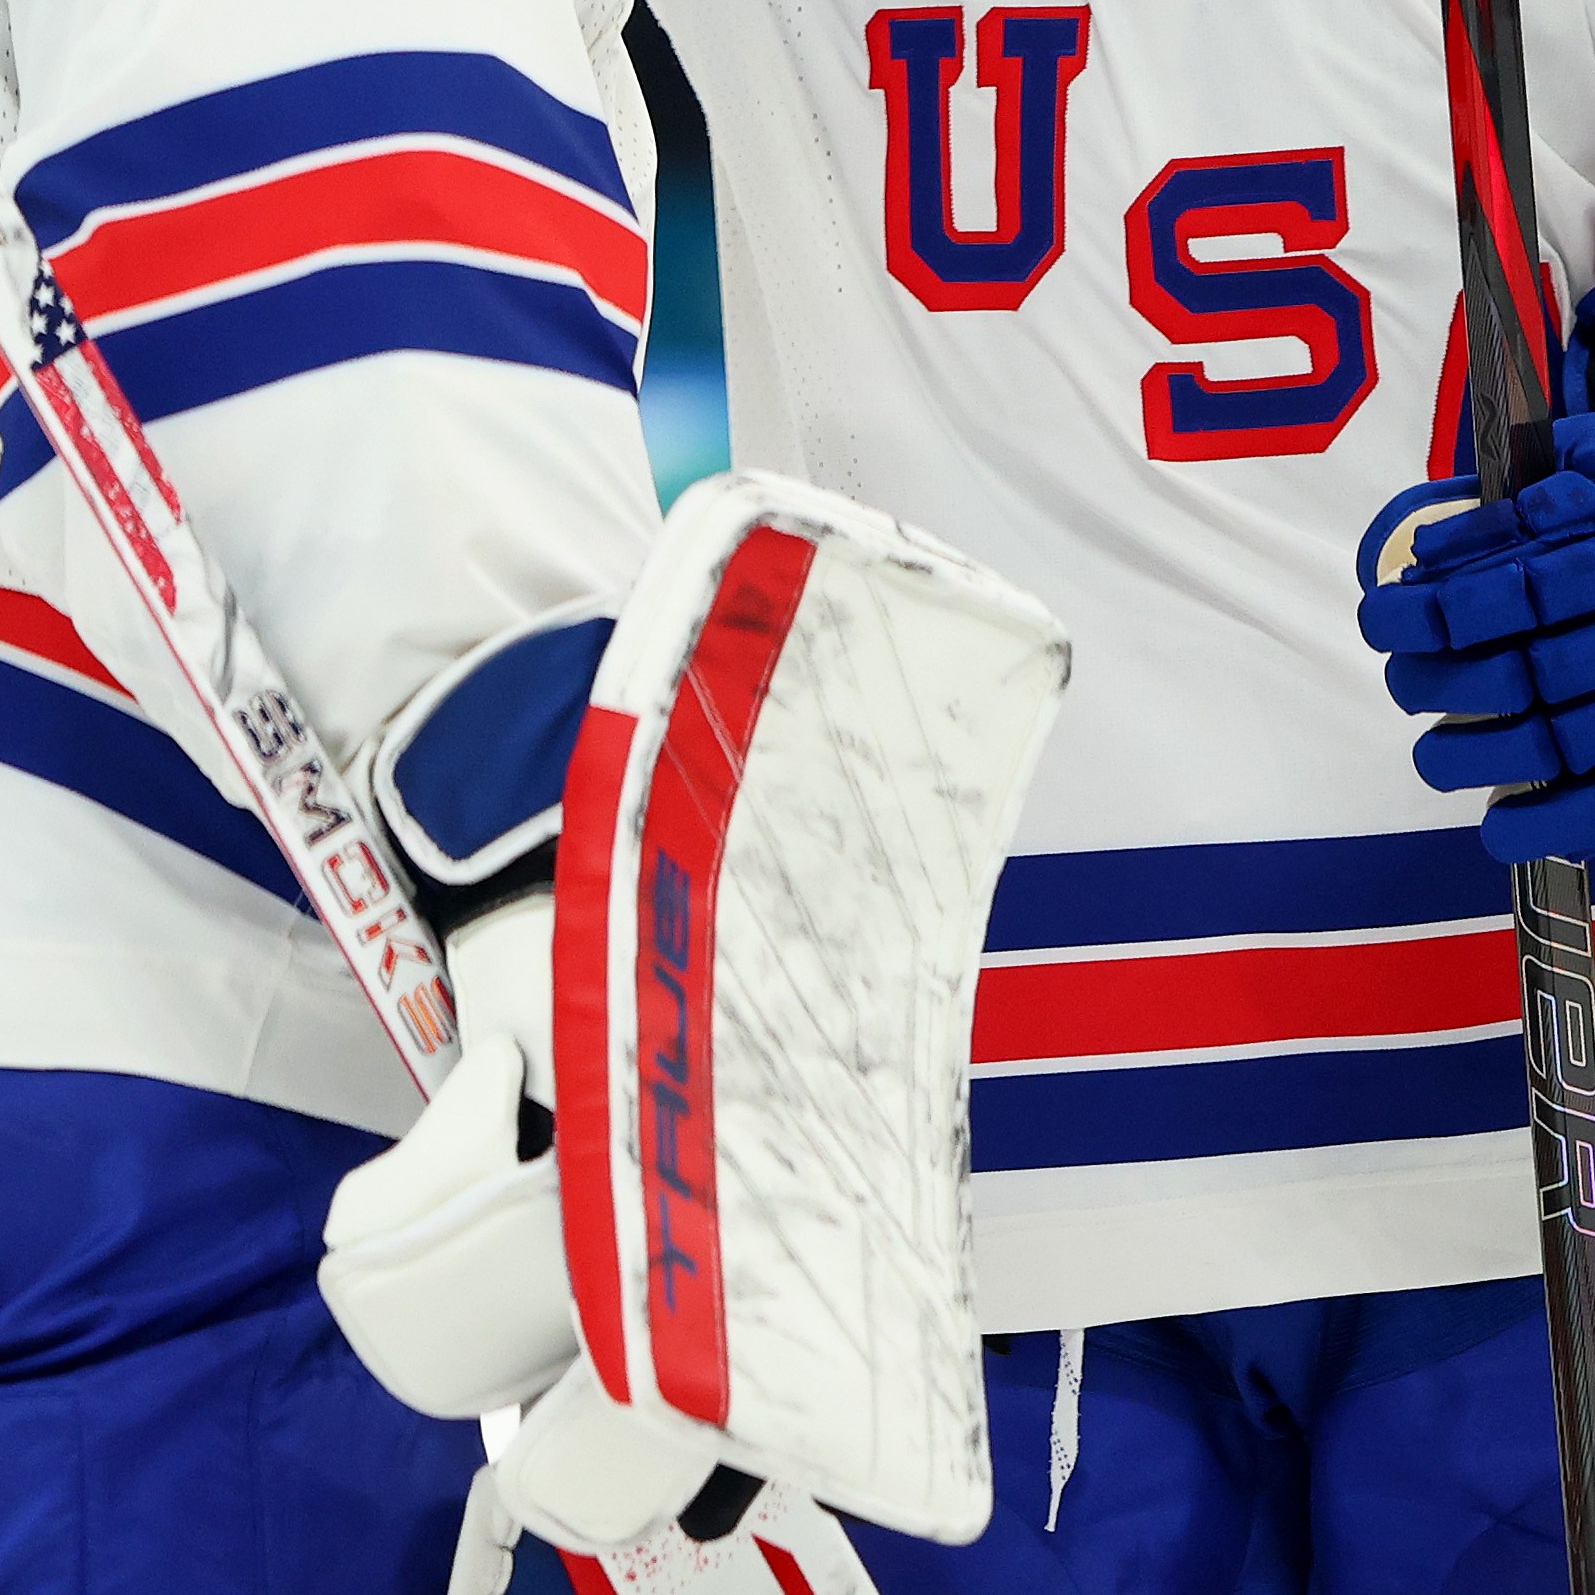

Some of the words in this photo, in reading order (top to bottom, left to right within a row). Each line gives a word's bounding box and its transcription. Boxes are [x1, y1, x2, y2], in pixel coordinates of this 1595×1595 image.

[865, 4, 1571, 482] US
[233, 688, 459, 1057] SMOKE
[652, 850, 696, 1311] TRUE
